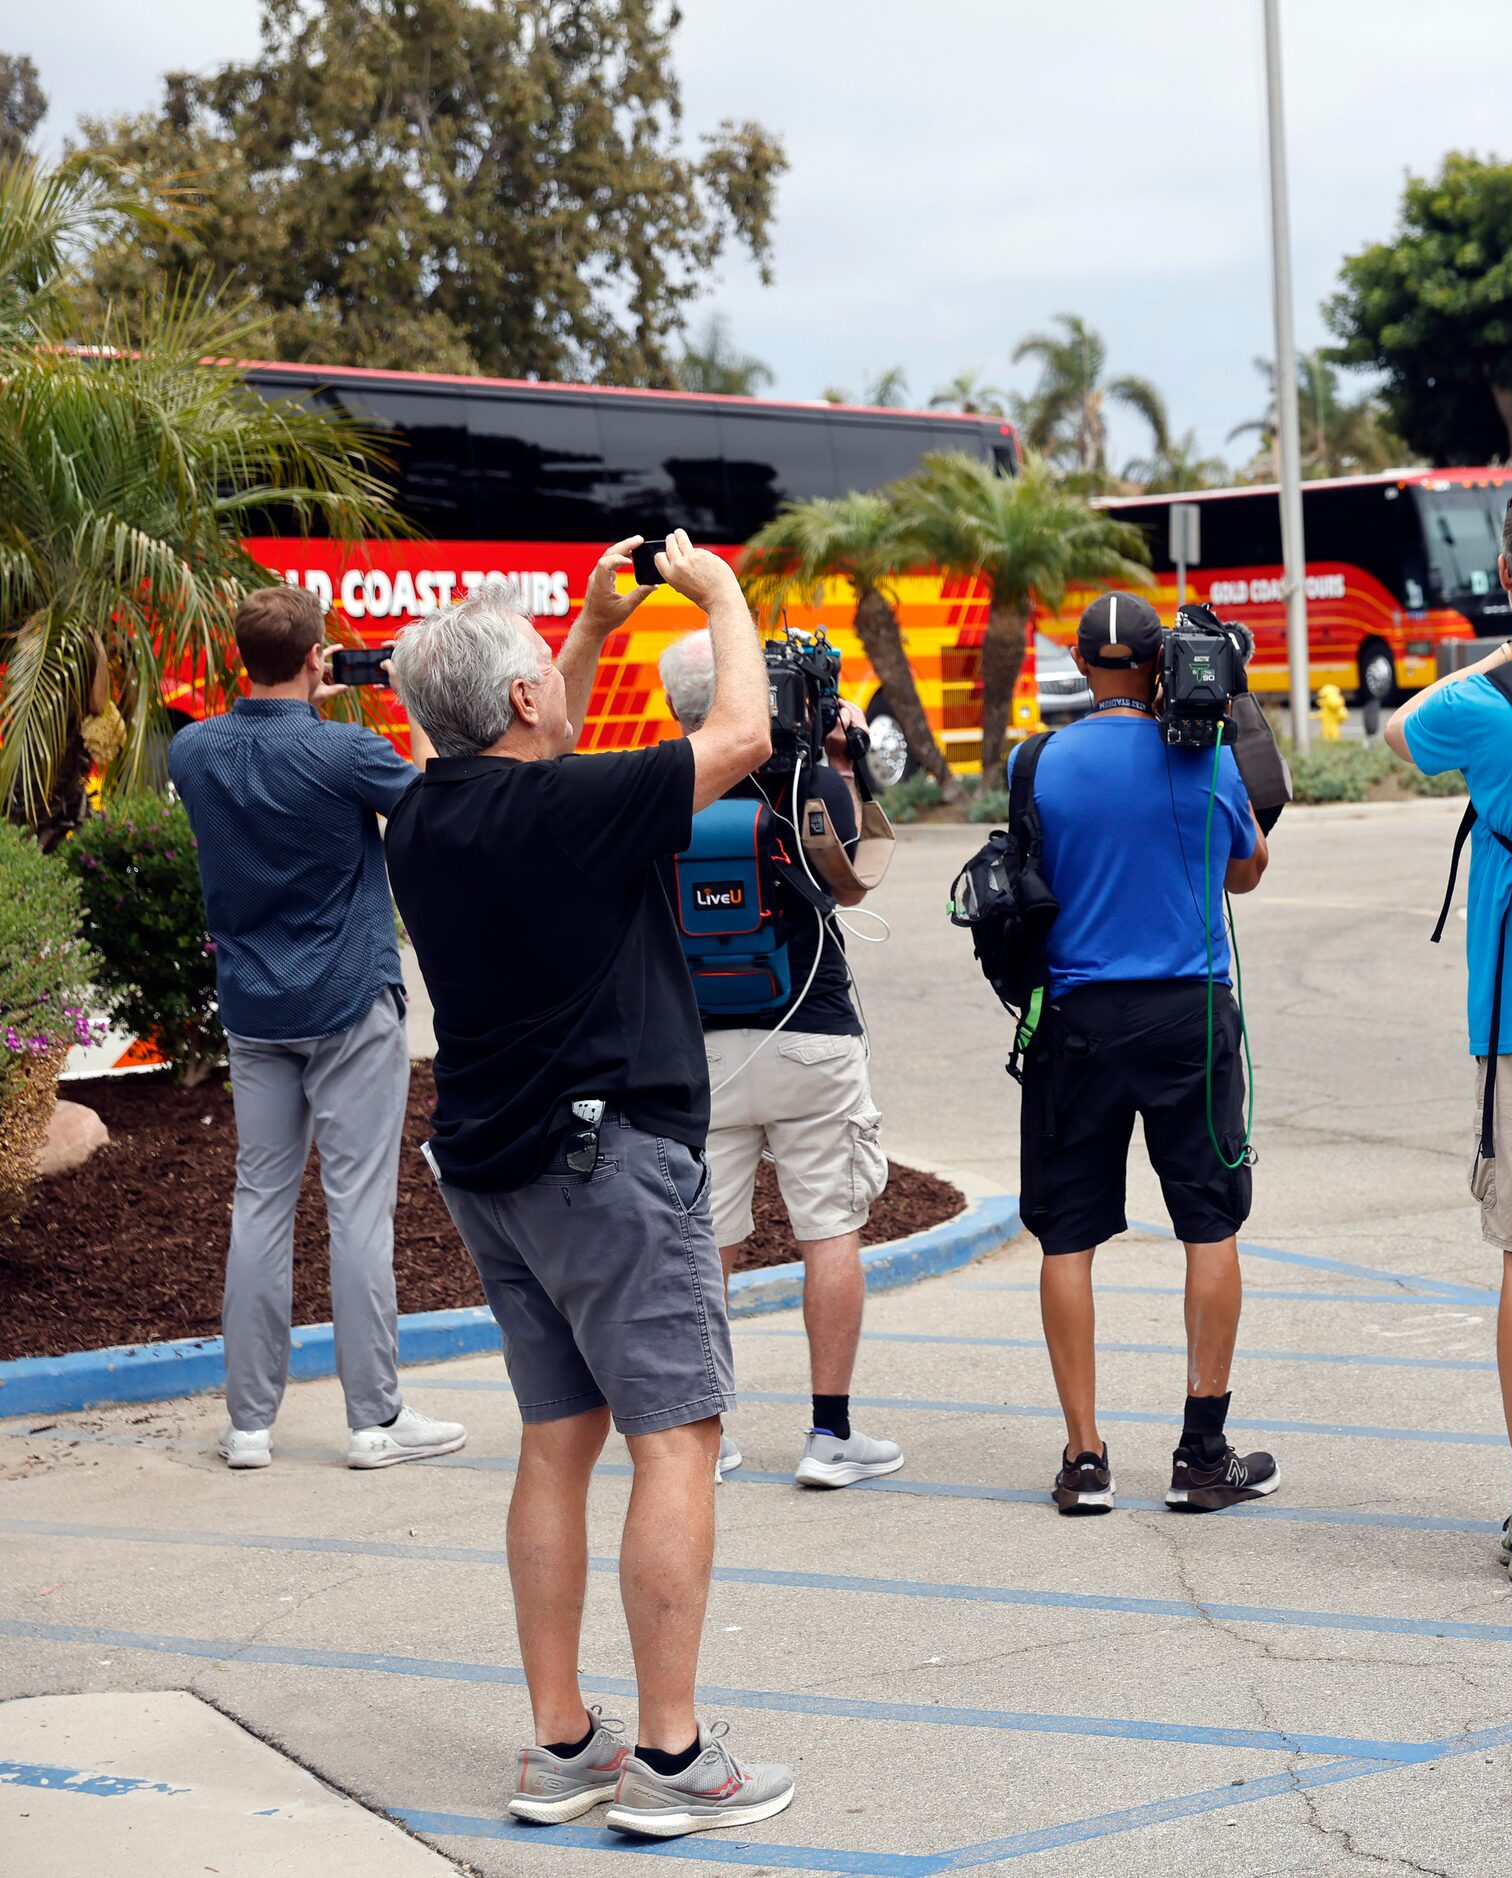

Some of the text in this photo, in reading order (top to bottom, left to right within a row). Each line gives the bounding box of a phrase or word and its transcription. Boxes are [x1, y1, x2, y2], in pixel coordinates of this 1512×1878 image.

[340, 568, 456, 617] COAST
[1099, 697, 1131, 710] STADIUM
[697, 889, 742, 905] LiveU
